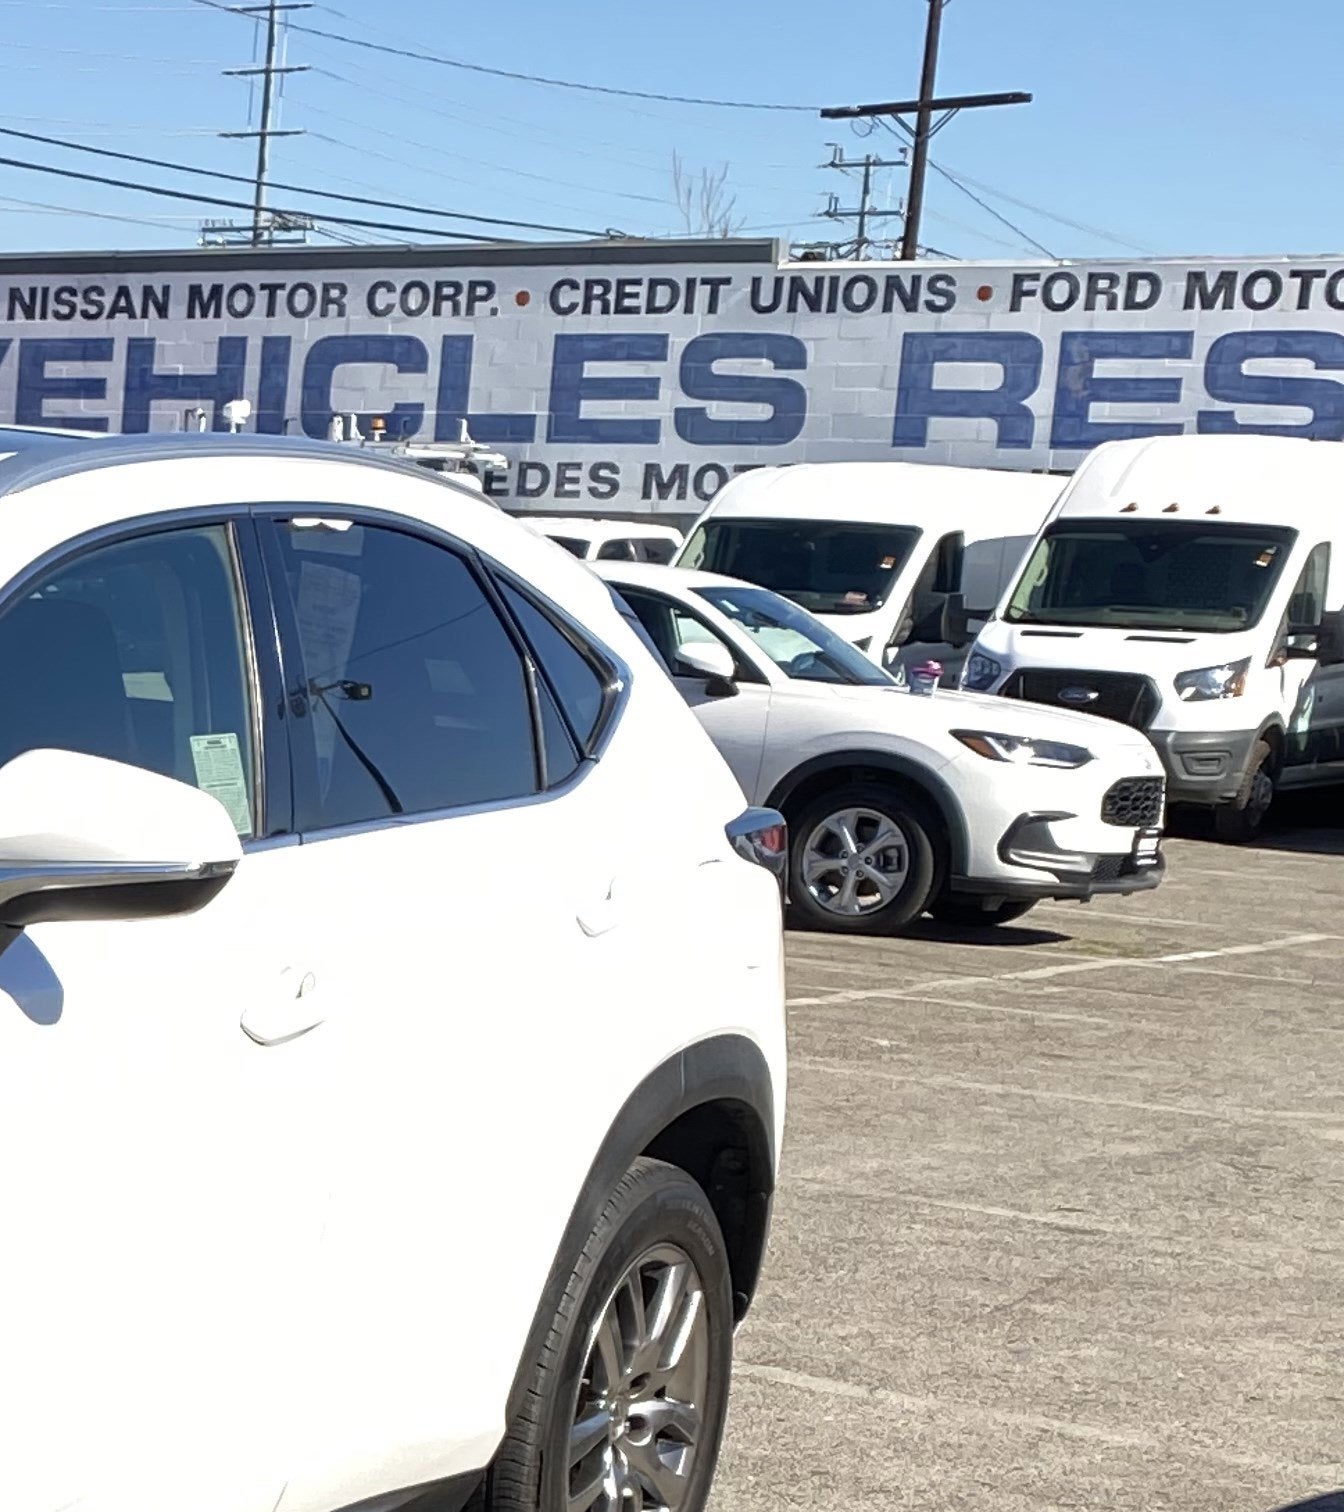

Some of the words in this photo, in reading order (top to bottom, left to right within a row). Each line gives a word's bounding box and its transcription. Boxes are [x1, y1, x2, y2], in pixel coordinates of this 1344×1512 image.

[7, 285, 170, 321] NISSAN
[186, 282, 348, 319] MOTOR
[366, 280, 499, 317] CORP.
[549, 277, 732, 315] CREDIT
[750, 274, 957, 313] UNIONS
[1009, 271, 1162, 311] FORD
[891, 330, 1344, 449] RES
[641, 462, 796, 501] MO
